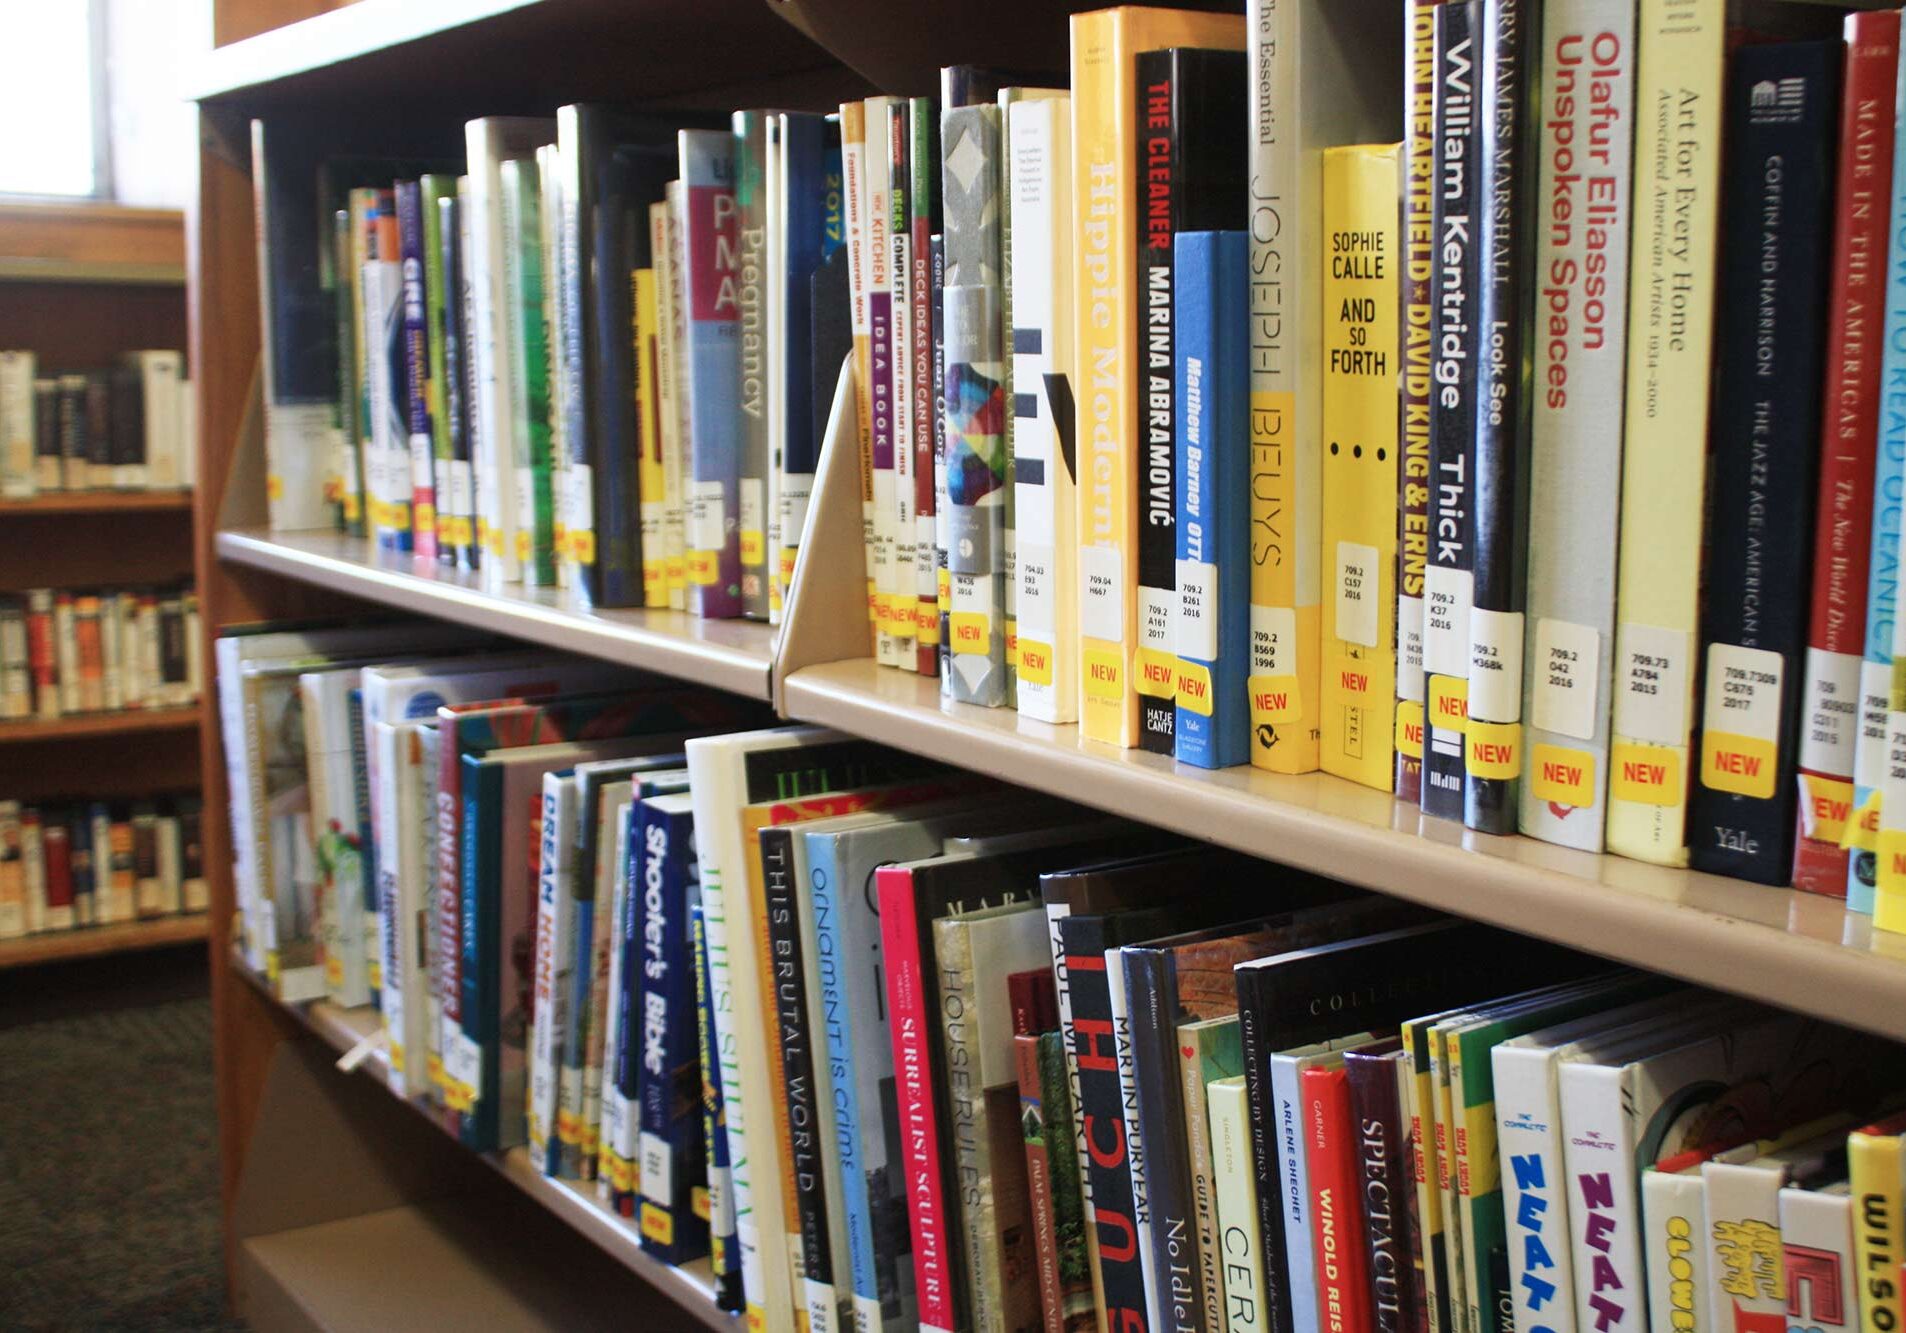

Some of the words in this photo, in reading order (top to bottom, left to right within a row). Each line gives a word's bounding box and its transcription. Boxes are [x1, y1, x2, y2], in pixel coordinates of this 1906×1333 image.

[1147, 80, 1170, 129] THE
[1260, 39, 1275, 145] Essential
[1497, 57, 1514, 138] JAMES
[1588, 32, 1621, 165] Olafur
[1678, 89, 1700, 131] Art
[1444, 38, 1472, 200] William
[1547, 34, 1583, 246] Unspoken
[1655, 89, 1672, 181] Associated
[1853, 100, 1877, 178] MADE
[1677, 139, 1699, 178] for
[826, 174, 840, 242] 2017
[847, 152, 858, 222] Foundations
[1148, 137, 1170, 250] CLEANER
[1408, 92, 1433, 282] HEARTFIELD
[1763, 155, 1783, 226] COFFIN
[1851, 191, 1872, 220] IN
[893, 189, 903, 230] DECKS
[1492, 147, 1511, 289] MARSHALL
[1653, 187, 1669, 267] American
[1669, 187, 1696, 262] Every
[874, 219, 885, 284] KITCHEN
[1085, 162, 1117, 328] Hippie
[1332, 232, 1384, 252] SOPHIE
[1583, 176, 1618, 350] Eliasson
[1761, 231, 1779, 272] AND
[1847, 232, 1871, 287] THE
[853, 240, 862, 291] Concrete
[895, 235, 905, 304] COMPLETE
[916, 259, 926, 299] DECK
[1251, 175, 1281, 375] JOSEPH
[1332, 256, 1384, 280] CALLE
[741, 225, 764, 417] Pregnancy
[856, 296, 864, 325] Work
[1149, 266, 1171, 368] MARINA
[1340, 299, 1376, 322] AND
[1435, 215, 1469, 408] Kentridge
[1650, 273, 1666, 328] Artists
[1669, 271, 1693, 352] Home
[875, 316, 885, 370] IDEA
[916, 304, 927, 348] IDEAS
[1349, 327, 1367, 347] SO
[1543, 259, 1578, 409] Spaces
[1757, 279, 1778, 376] HARRISON
[917, 351, 928, 385] YOU
[935, 338, 946, 390] Juan
[1331, 349, 1386, 376] FORTH
[1407, 303, 1431, 397] DAVID
[1490, 321, 1508, 376] Look
[1839, 300, 1865, 440] AMERICAS
[876, 384, 887, 446] BOOK
[918, 388, 928, 422] CAN
[1186, 356, 1202, 444] Matthew
[1489, 382, 1507, 426] See
[1754, 401, 1770, 434] THE
[918, 424, 928, 452] USE
[1149, 376, 1175, 527] ABRAMOVIĆ
[1406, 403, 1430, 477] KING
[1186, 445, 1202, 517] Barney
[1751, 440, 1769, 485] JAZZ
[1253, 407, 1281, 567] BEUYS
[1405, 482, 1428, 507] &
[1835, 479, 1853, 510] The
[1438, 454, 1465, 563] Thick
[1832, 513, 1852, 550] New
[957, 586, 973, 597] 2016
[1024, 585, 1039, 597] 2016
[1089, 575, 1111, 586] 709.04
[1089, 586, 1107, 596] H667
[1183, 583, 1203, 595] 709.2
[1344, 565, 1364, 577] 709.2
[1344, 577, 1362, 588] C157
[1742, 537, 1762, 631] AMERICAN
[1828, 556, 1850, 604] World
[1148, 605, 1167, 616] 709.2
[1182, 596, 1201, 606] B261
[1183, 607, 1201, 618] 2016
[1344, 589, 1361, 601] 2016
[1430, 605, 1447, 616] K37
[1431, 592, 1455, 604] 709.2
[957, 625, 980, 641] NEW
[1148, 617, 1166, 628] A161
[1148, 629, 1165, 640] 2017
[1254, 631, 1278, 643] 709.2
[1430, 618, 1451, 630] 2016
[1023, 653, 1045, 671] NEW
[1254, 645, 1275, 656] B569
[1254, 657, 1275, 669] 1996
[1473, 643, 1498, 657] 709.2
[1550, 647, 1578, 662] 709.2
[1632, 654, 1669, 669] 709.73
[1091, 664, 1117, 683] NEW
[1144, 664, 1172, 684] NEW
[1178, 675, 1206, 698] NEW
[1341, 672, 1368, 693] NEW
[1549, 675, 1573, 689] 2016
[1631, 668, 1659, 681] A784
[1631, 682, 1658, 695] 2015
[1724, 666, 1777, 685] 709.7309
[1147, 708, 1173, 724] HATJE
[1255, 693, 1287, 711] NEW
[1723, 697, 1751, 712] 2017
[1147, 719, 1173, 736] CANTZ
[1185, 719, 1201, 732] Yale
[1811, 729, 1838, 745] 2015
[1474, 743, 1512, 764] NEW
[1543, 762, 1583, 786] NEW
[1623, 761, 1666, 785] NEW
[1714, 750, 1761, 777] NEW
[1715, 826, 1759, 855] Yale
[645, 823, 668, 979] Shooter's
[766, 847, 789, 925] THIS
[775, 939, 801, 1061] BRUTAL
[645, 990, 666, 1075] Bible
[942, 967, 972, 1091] HOUSE
[830, 1055, 848, 1080] is
[1244, 1008, 1259, 1101] COLLECTING
[1185, 1068, 1197, 1110] Paper
[789, 1076, 816, 1193] WORLD
[1114, 1016, 1138, 1109] MARTIN
[1126, 1118, 1150, 1225] PURYEAR
[1252, 1105, 1262, 1125] BY
[1283, 1099, 1296, 1155] ARLENE
[1313, 1099, 1326, 1150] GARNER
[1503, 1120, 1549, 1132] COMPLETE
[1517, 1112, 1532, 1121] THE
[1586, 1131, 1601, 1139] THE
[901, 1017, 928, 1167] SURREALIST
[916, 1171, 942, 1310] SCULPTURE
[953, 1099, 980, 1207] RULES
[1255, 1128, 1268, 1182] DESIGN
[1572, 1137, 1616, 1151] COMPLETE
[1031, 1159, 1043, 1194] PALM
[1196, 1173, 1209, 1220] GUIDE
[1288, 1158, 1301, 1224] SHECHET
[1036, 1198, 1048, 1253] SPRINGS
[1165, 1216, 1188, 1258] No
[1199, 1227, 1211, 1245] TO
[1319, 1188, 1338, 1280] WINOLD
[1510, 1153, 1556, 1312] NEAT
[1577, 1172, 1625, 1333] NEAT
[1170, 1264, 1193, 1319] Idle
[1666, 1216, 1698, 1333] CLOWE
